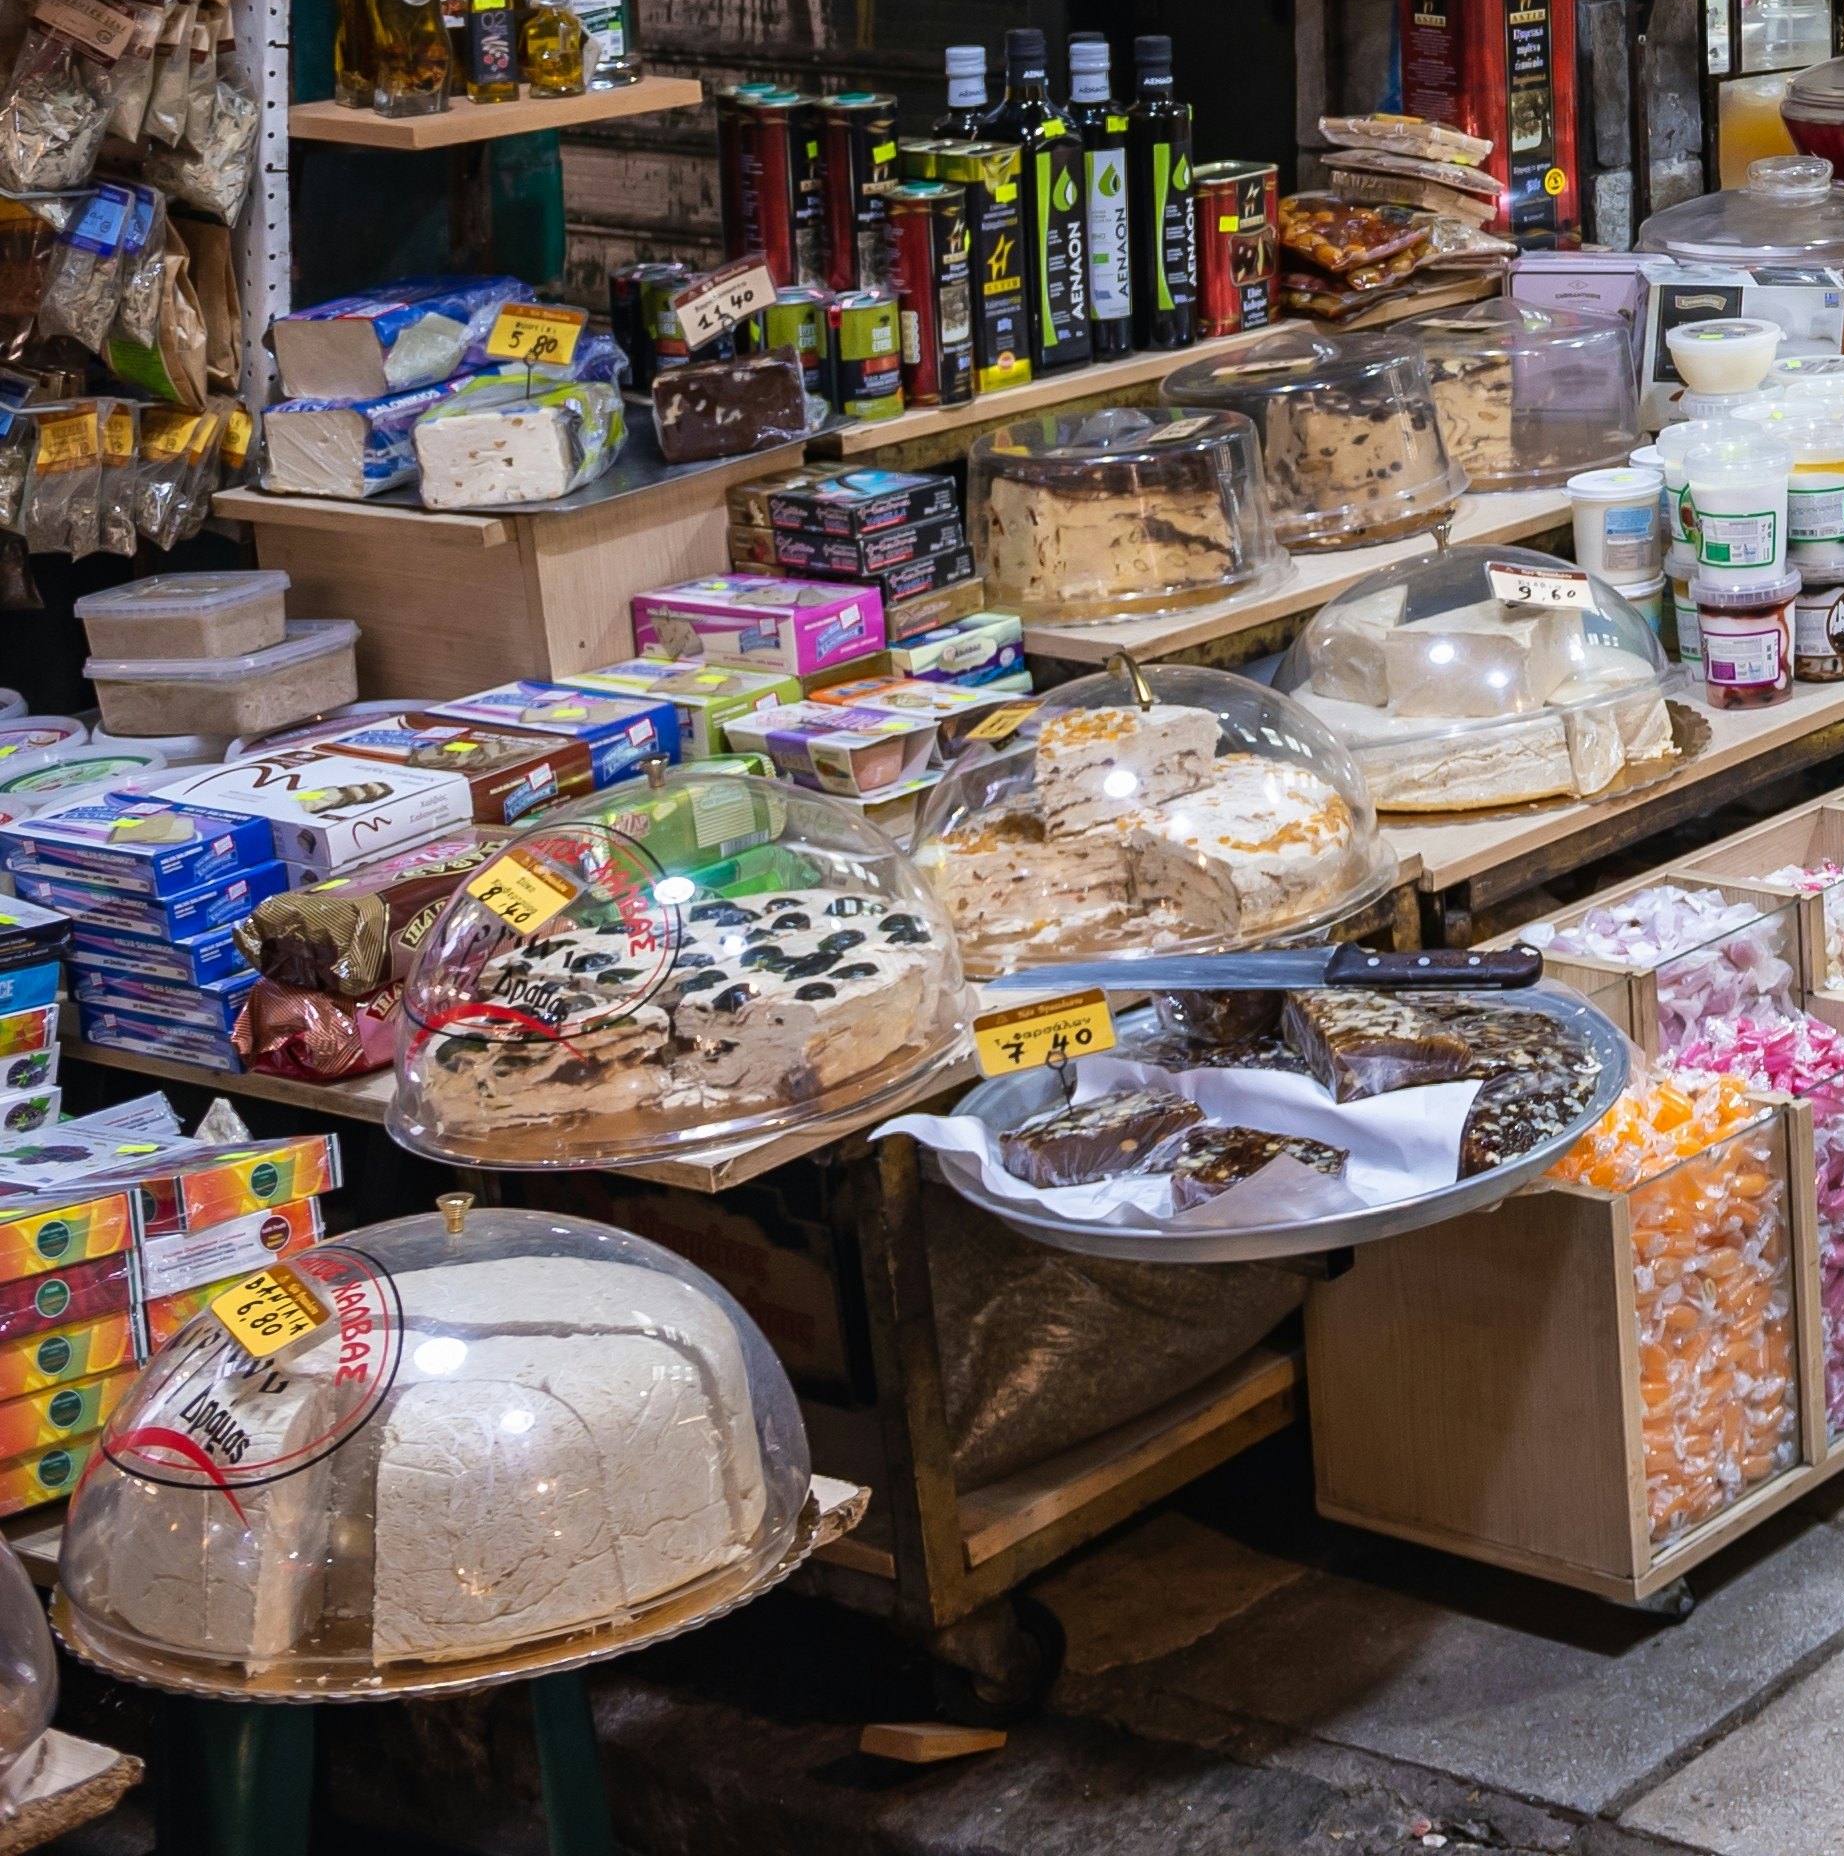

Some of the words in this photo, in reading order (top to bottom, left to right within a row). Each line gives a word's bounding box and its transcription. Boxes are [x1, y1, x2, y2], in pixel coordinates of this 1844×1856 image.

[1510, 10, 1546, 24] ASTIR
[1067, 220, 1085, 321] AENAON
[1115, 206, 1131, 296] AENAON
[1001, 1041, 1025, 1065] 7
[331, 1280, 372, 1387] ΧΑΛΒΑΣ
